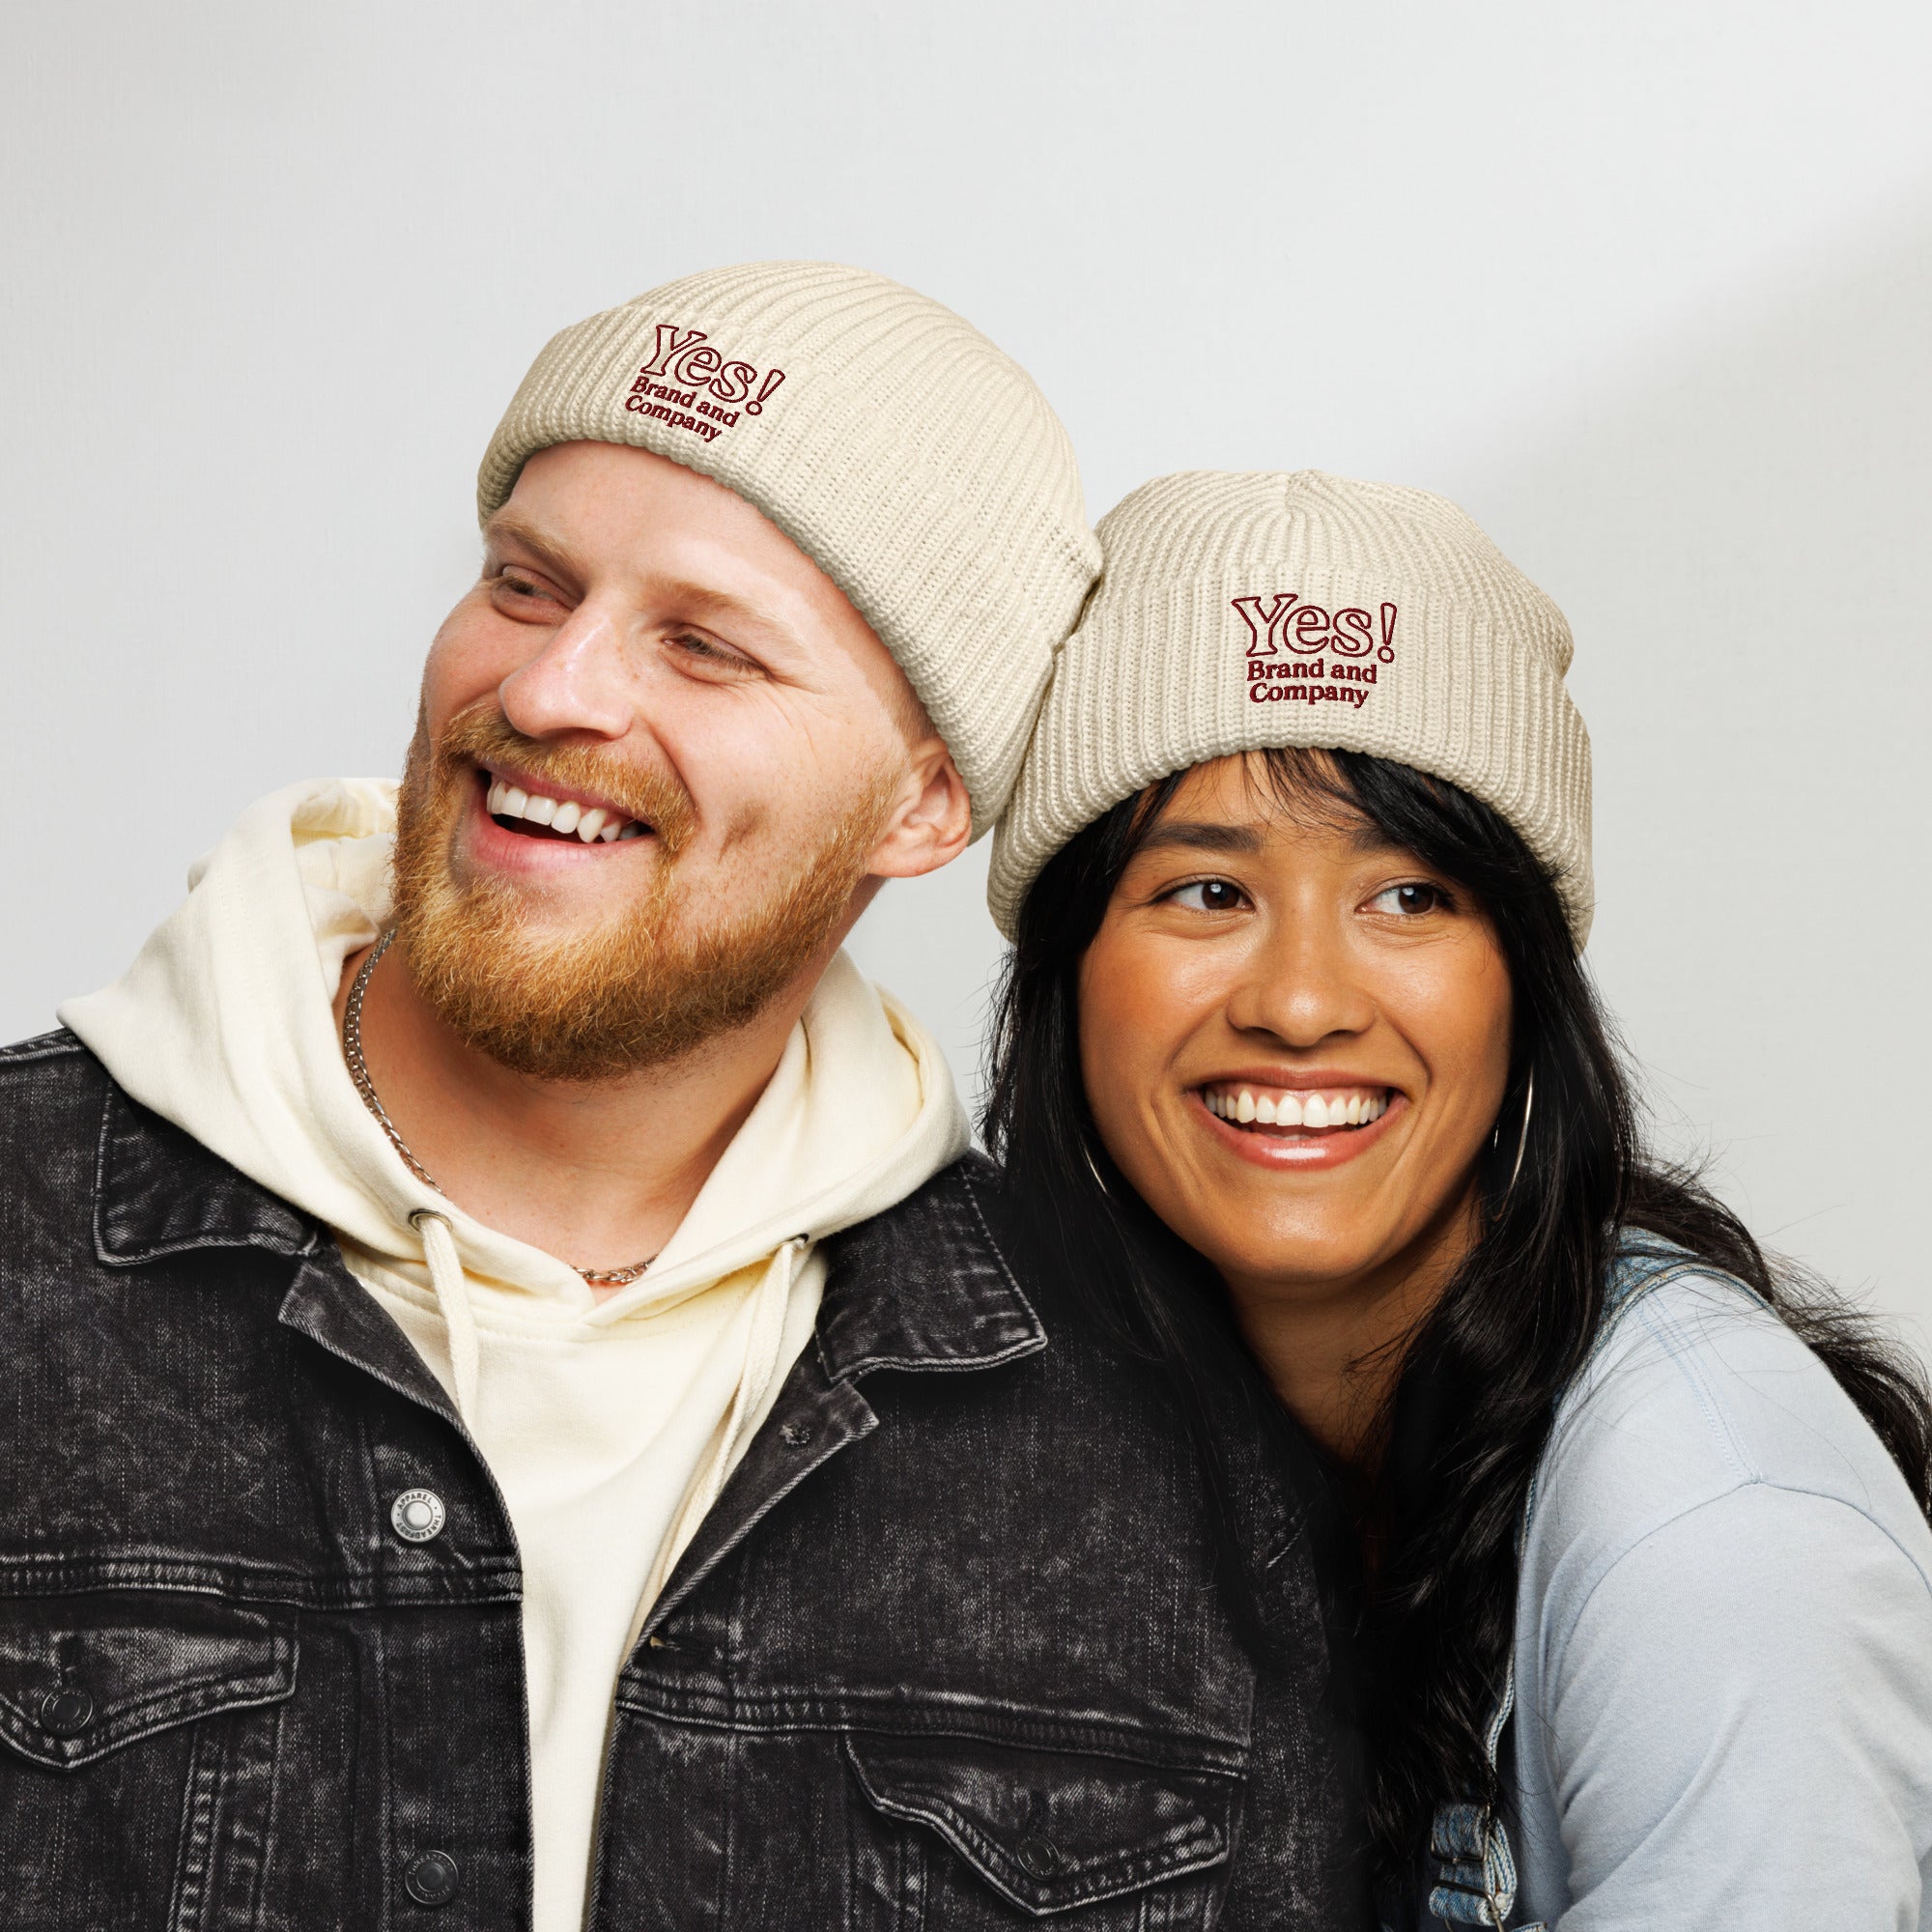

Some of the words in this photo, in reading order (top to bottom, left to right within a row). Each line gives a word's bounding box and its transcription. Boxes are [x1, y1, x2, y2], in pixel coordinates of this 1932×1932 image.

[640, 325, 785, 416] Yes!
[625, 395, 723, 443] Company
[630, 376, 697, 409] Brand
[696, 401, 740, 428] and
[1231, 593, 1398, 664] Yes!
[1246, 658, 1324, 682] Brand
[1330, 664, 1378, 685] and
[1249, 682, 1370, 709] Company
[397, 1492, 433, 1510] APPAREL
